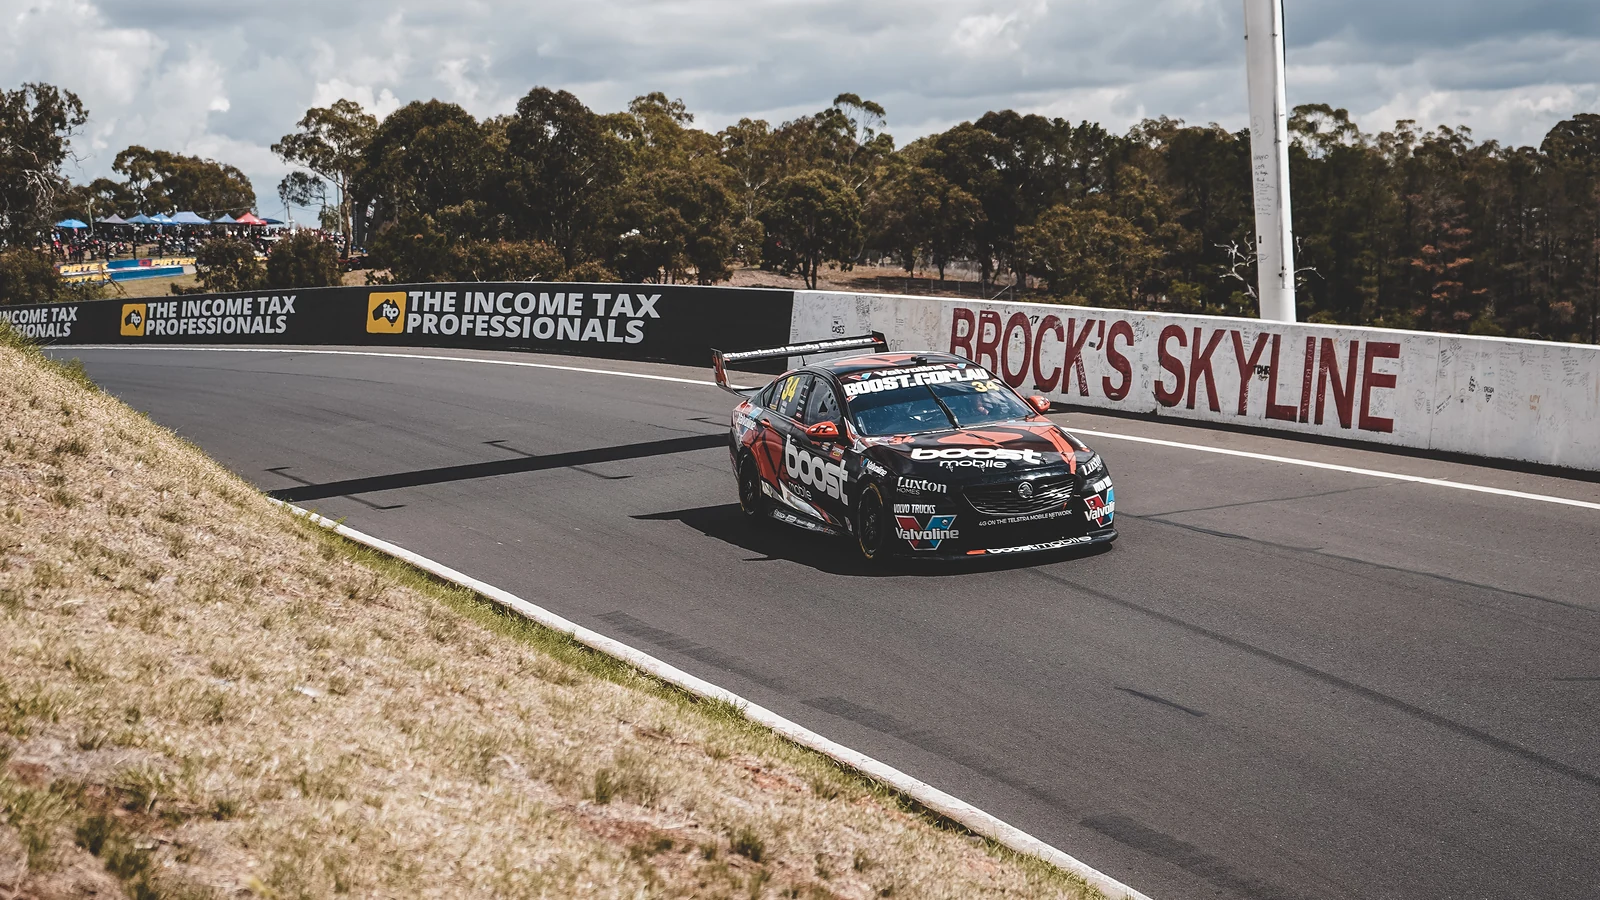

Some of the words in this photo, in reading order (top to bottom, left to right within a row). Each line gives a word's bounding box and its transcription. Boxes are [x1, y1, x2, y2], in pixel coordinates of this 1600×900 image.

[147, 301, 178, 319] THE
[181, 297, 253, 317] INCOME
[257, 294, 297, 315] TAX
[408, 290, 457, 313] THE
[463, 291, 584, 316] INCOME
[592, 293, 663, 319] TAX
[51, 306, 79, 322] TAX
[145, 315, 287, 336] PROFESSIONALS
[406, 313, 645, 344] PROFESSIONALS
[873, 364, 947, 377] Valvoline
[951, 307, 1135, 401] BROCK'S
[1153, 323, 1401, 434] SKYLINE
[781, 375, 800, 403] 34
[843, 368, 990, 396] BOOST.COM.AU
[971, 381, 1000, 393] 34
[910, 447, 1042, 465] boost
[939, 459, 1008, 469] mobile
[785, 434, 849, 506] boost
[788, 480, 813, 501] mobile
[896, 487, 921, 496] HOMES
[897, 476, 948, 494] Luxton
[894, 503, 910, 514] VOLVO
[911, 504, 936, 514] TRUCKS
[1008, 514, 1030, 524] TELSTRA
[1030, 512, 1049, 521] MOBILE
[1048, 509, 1073, 520] NETWORK
[895, 526, 960, 541] Valvoline
